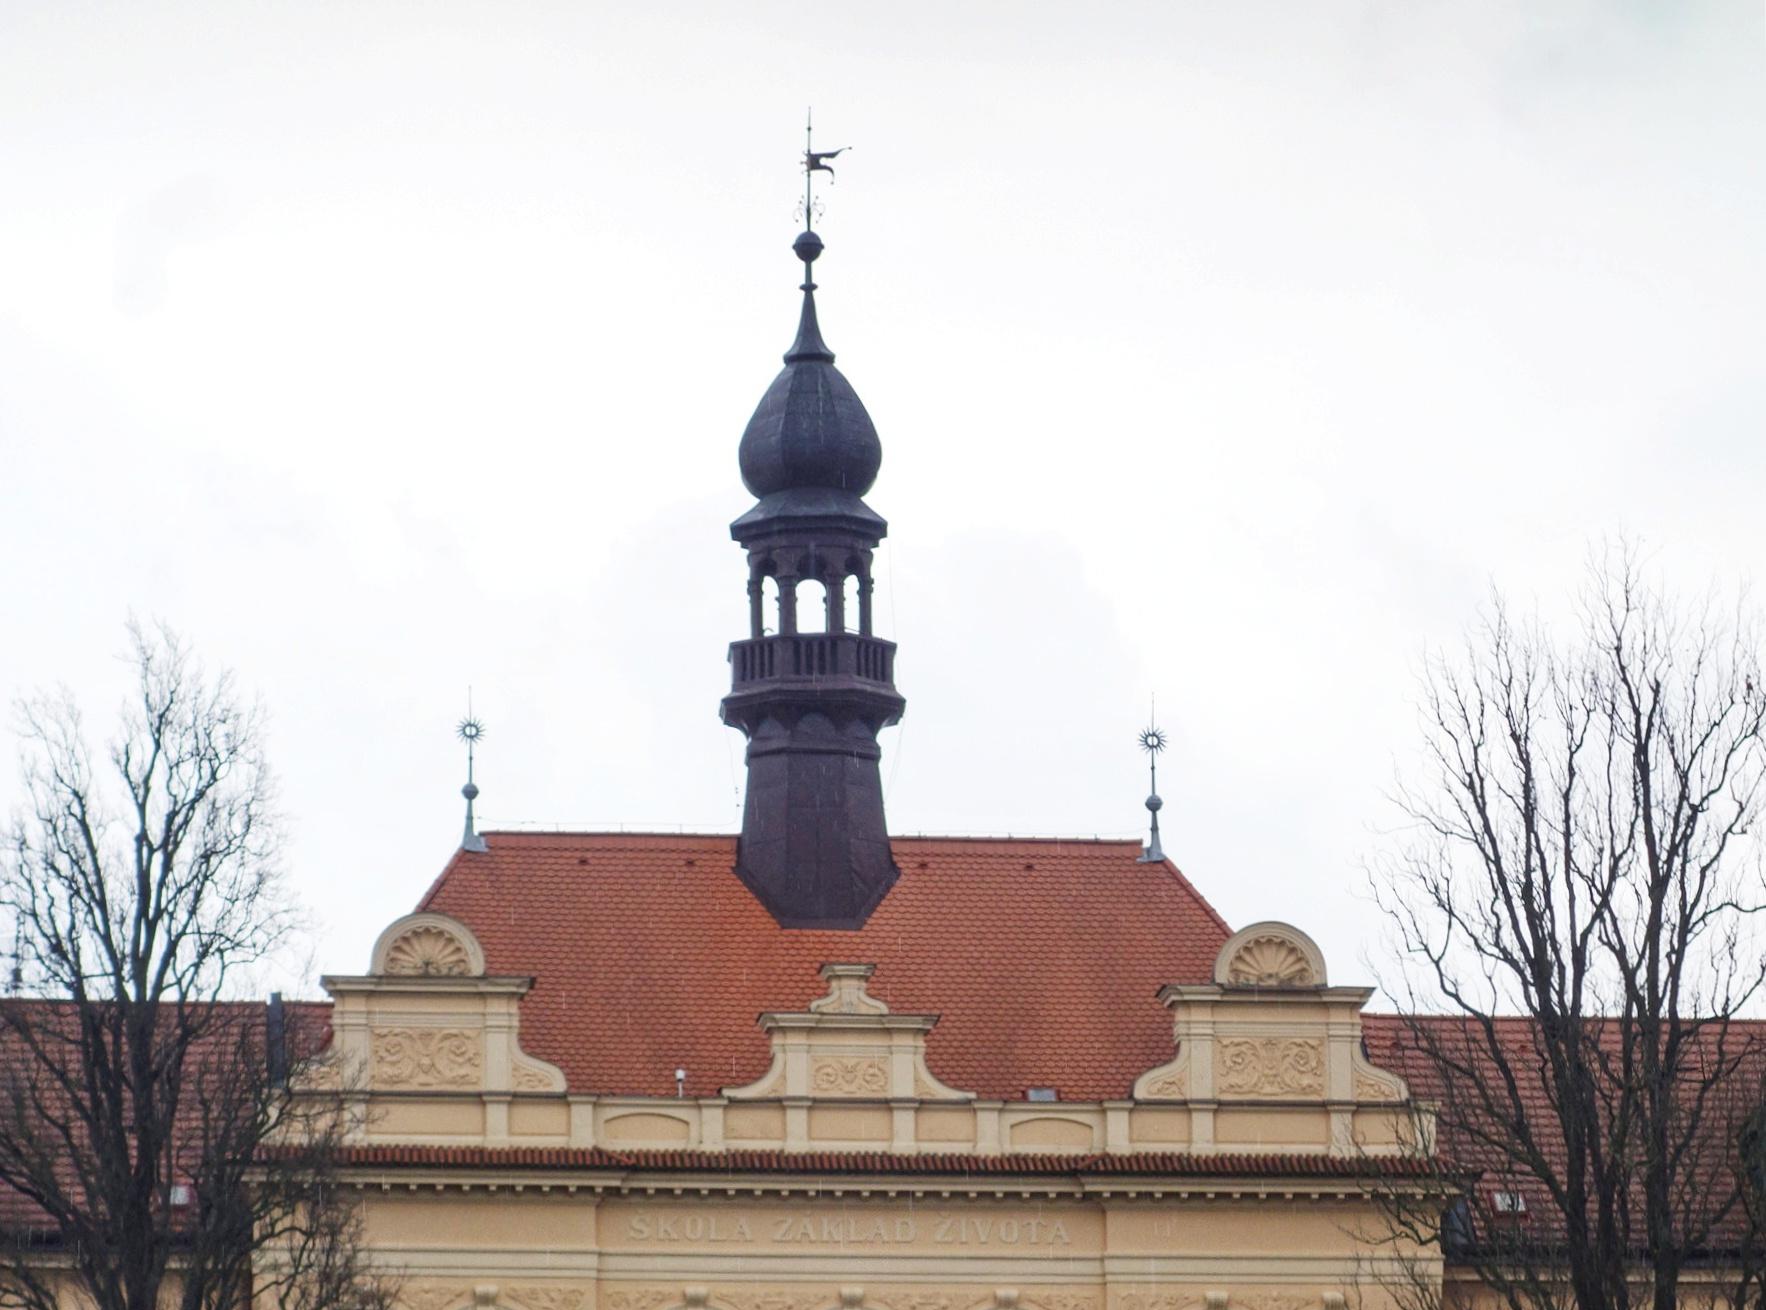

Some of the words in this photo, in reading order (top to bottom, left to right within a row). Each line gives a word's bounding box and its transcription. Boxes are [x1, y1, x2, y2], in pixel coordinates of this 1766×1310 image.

[627, 1210, 754, 1242] ŠKOLA
[771, 1212, 917, 1244] ZÁKLAD
[934, 1210, 1072, 1245] ŽIVOTA
